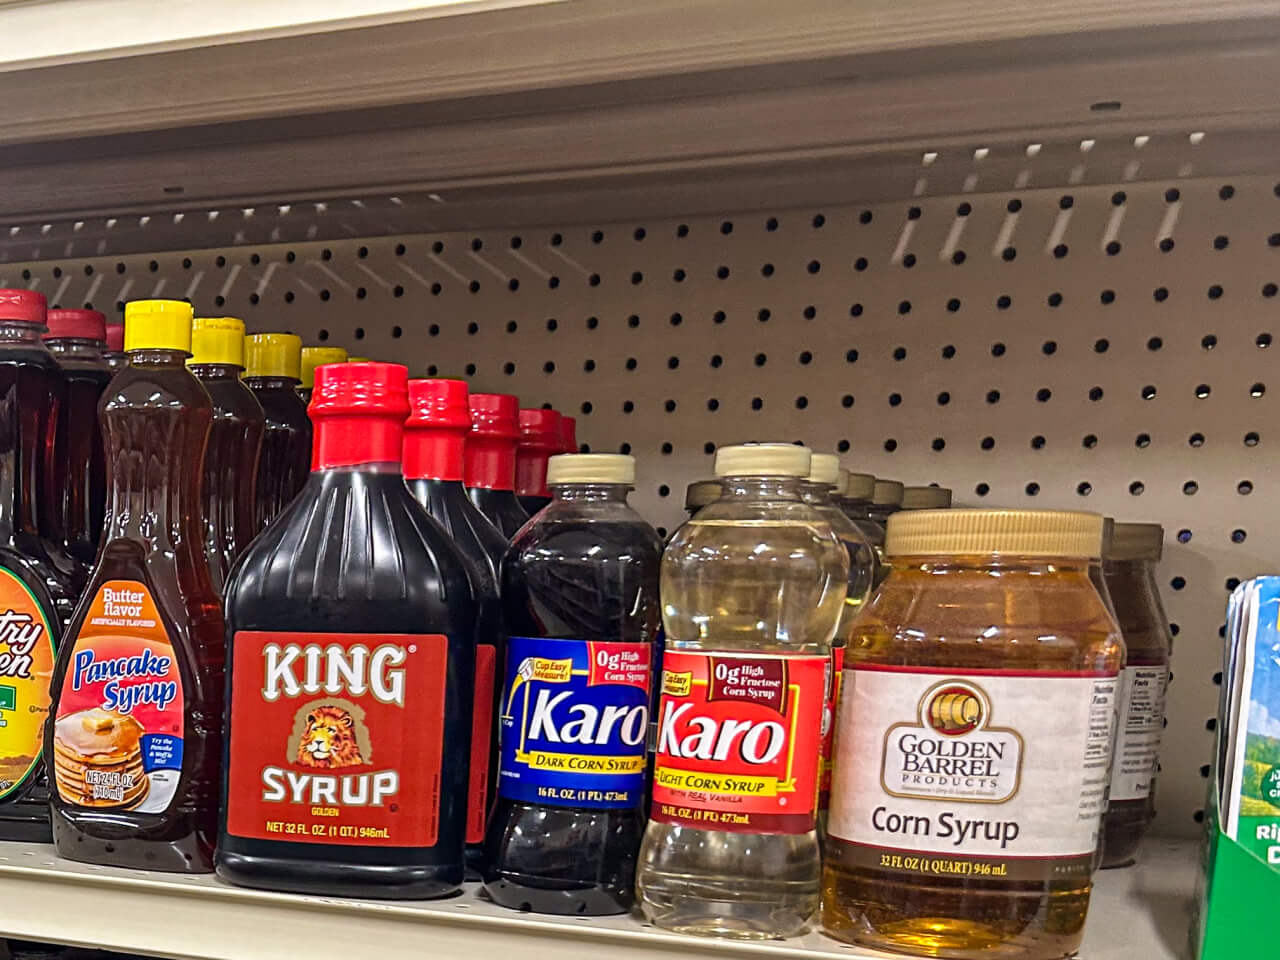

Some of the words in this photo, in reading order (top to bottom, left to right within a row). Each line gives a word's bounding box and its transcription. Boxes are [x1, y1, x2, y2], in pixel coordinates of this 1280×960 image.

[103, 588, 144, 603] Butter
[104, 602, 141, 617] flavor
[73, 649, 170, 691] Pancake
[261, 642, 407, 709] KING
[534, 670, 568, 681] Measure!
[535, 661, 548, 671] Cup
[550, 662, 567, 673] Easy
[715, 664, 739, 685] 0g
[741, 665, 764, 677] High
[741, 676, 780, 687] Fructose
[103, 681, 176, 713] Syrup
[723, 686, 746, 697] Corn
[748, 687, 775, 699] Syrup
[527, 689, 647, 745] Karo
[659, 701, 786, 765] Karo
[899, 734, 1006, 761] GOLDEN
[535, 756, 565, 768] DARK
[568, 757, 603, 770] CORN
[606, 759, 638, 771] SYRUP
[902, 752, 1000, 779] BARREL
[86, 771, 101, 784] NET
[102, 773, 111, 785] 24
[112, 775, 121, 786] FL
[122, 776, 133, 786] OZ
[261, 765, 399, 807] SYRUP
[686, 775, 721, 790] CORN
[724, 778, 764, 793] SYRUP
[902, 774, 998, 788] PRODUCTS
[311, 807, 339, 817] GOLDEN
[267, 821, 284, 833] NET
[285, 823, 296, 834] 32
[329, 825, 337, 837] (1
[872, 807, 930, 836] Corn
[937, 814, 1019, 848] Syrup
[879, 855, 891, 867] 32
[891, 855, 903, 868] FL
[904, 856, 919, 869] OZ
[920, 858, 930, 872] (1
[931, 859, 972, 875] QUART)
[974, 862, 991, 875] 946
[992, 863, 1007, 876] mL
